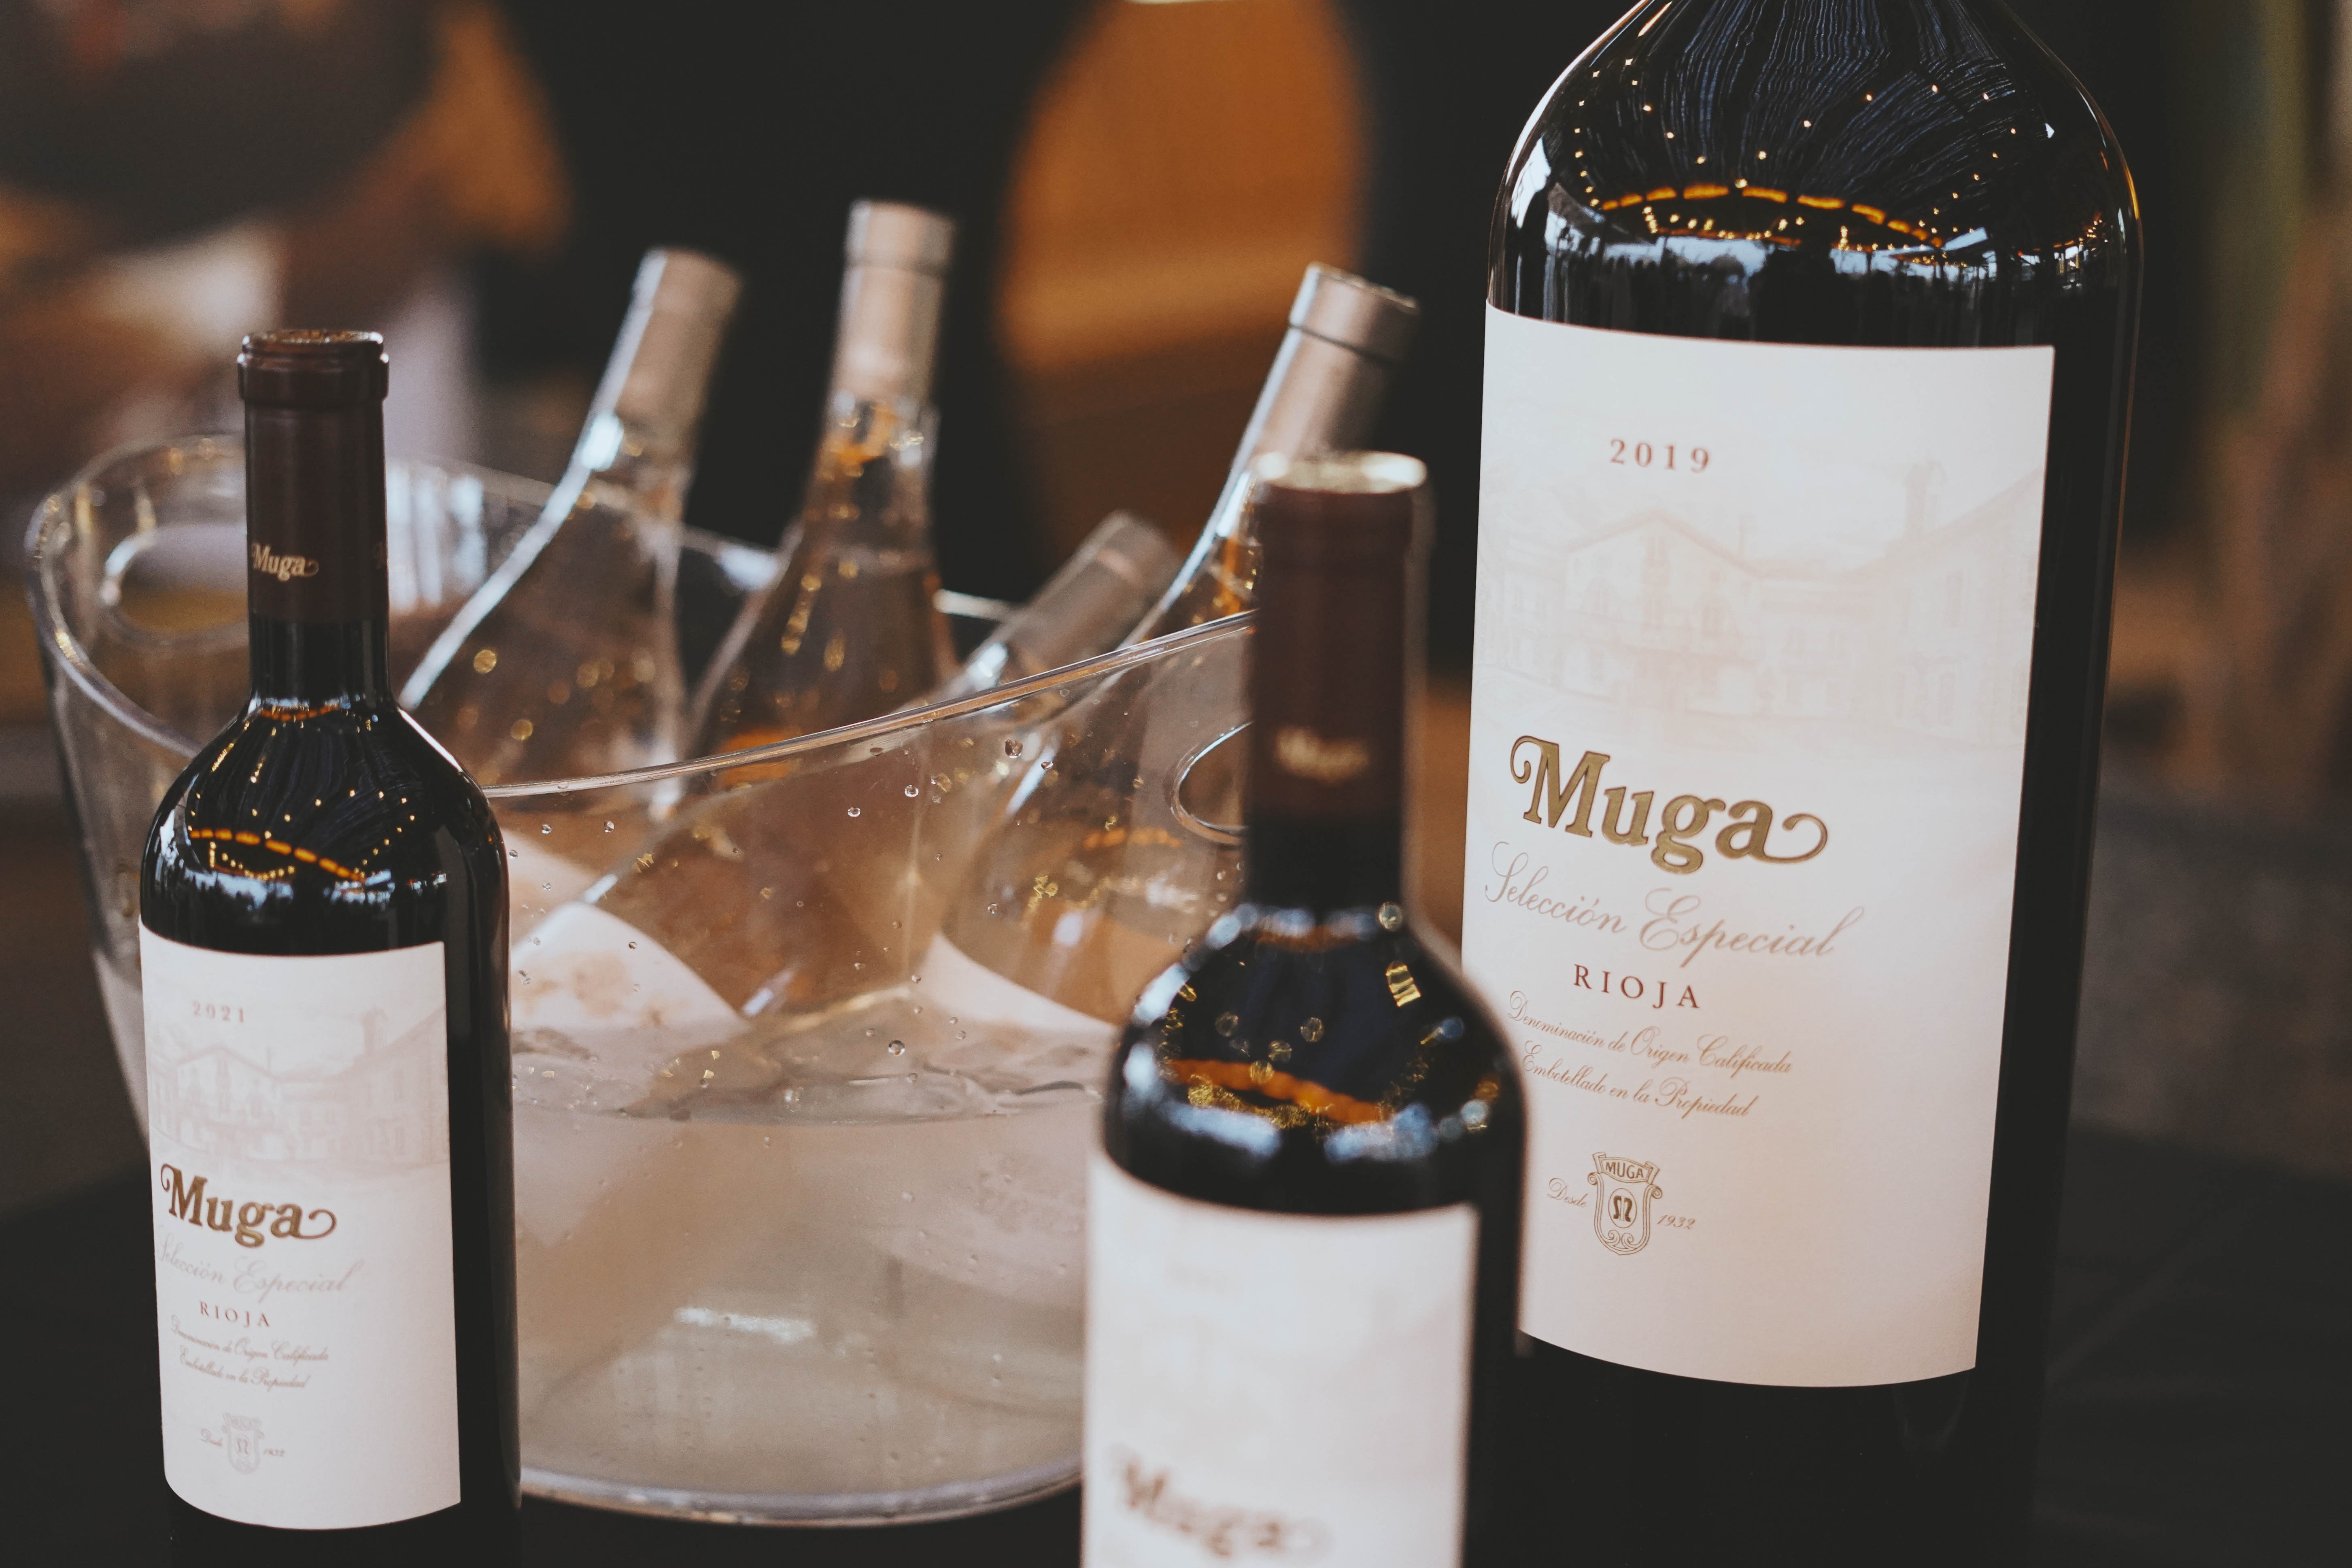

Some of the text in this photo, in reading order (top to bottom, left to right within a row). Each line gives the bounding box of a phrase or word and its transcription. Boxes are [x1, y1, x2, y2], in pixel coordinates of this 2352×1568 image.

[1610, 438, 1710, 473] 2019
[251, 541, 320, 582] Muga
[1509, 735, 1828, 874] Muga
[1485, 841, 1864, 969] Selección Especial
[1573, 964, 1700, 1009] RIOJA
[192, 1001, 244, 1023] 2021
[1508, 990, 1792, 1079] Denominación de Origen Calificada
[1522, 1041, 1759, 1119] Embotellado en la Propiedad
[1606, 1161, 1644, 1179] MUGA
[161, 1164, 337, 1248] Muga
[1547, 1177, 1696, 1230] Desde 1932
[233, 1256, 364, 1303] Especial
[200, 1300, 270, 1328] RIOJA
